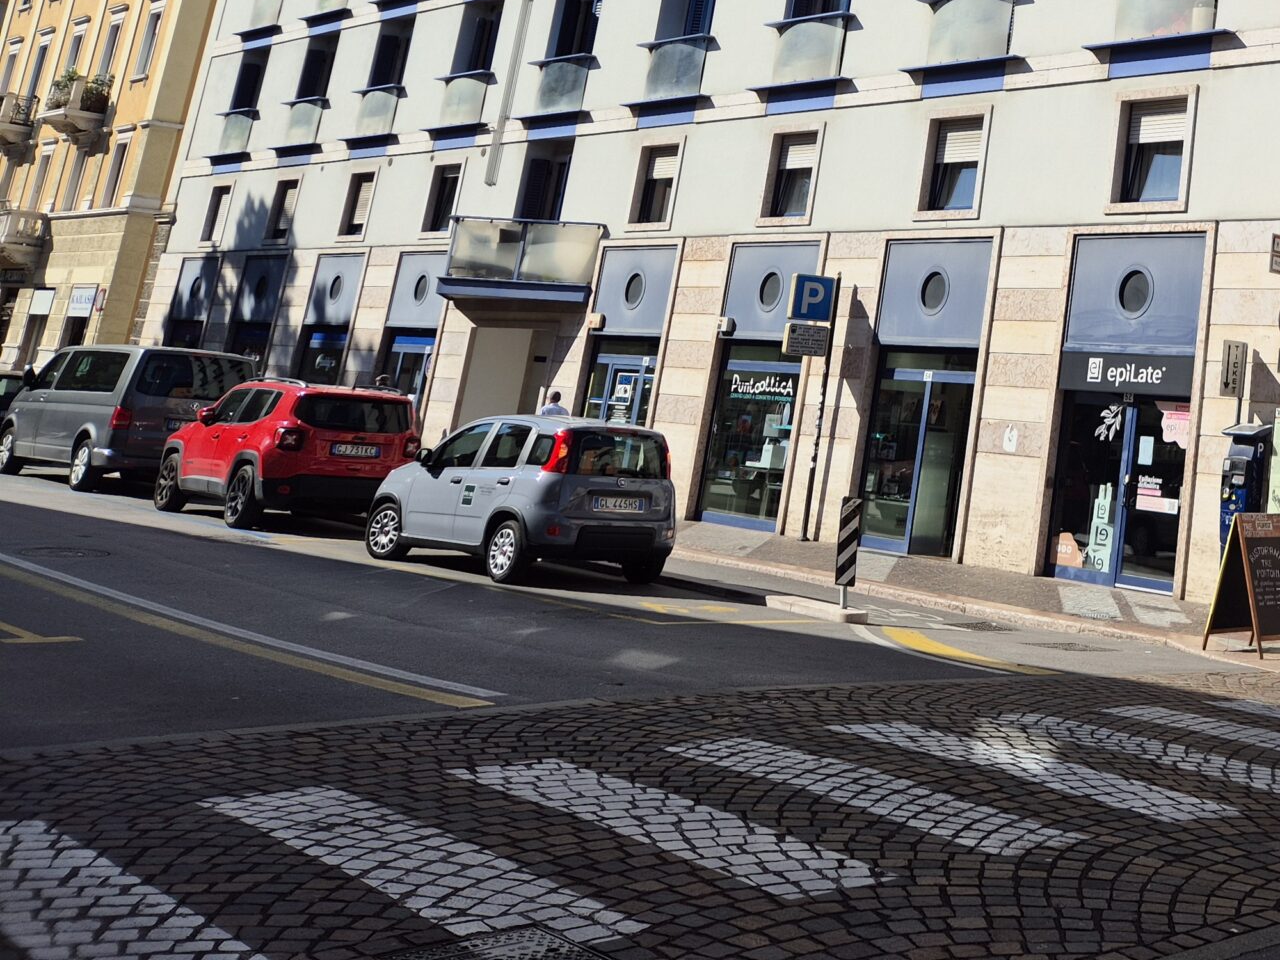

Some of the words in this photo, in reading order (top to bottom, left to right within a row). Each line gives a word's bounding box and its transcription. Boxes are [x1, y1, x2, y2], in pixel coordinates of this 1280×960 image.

[801, 280, 825, 314] P
[1232, 345, 1240, 394] TICKET
[1124, 393, 1133, 401] 52
[1257, 442, 1265, 458] P
